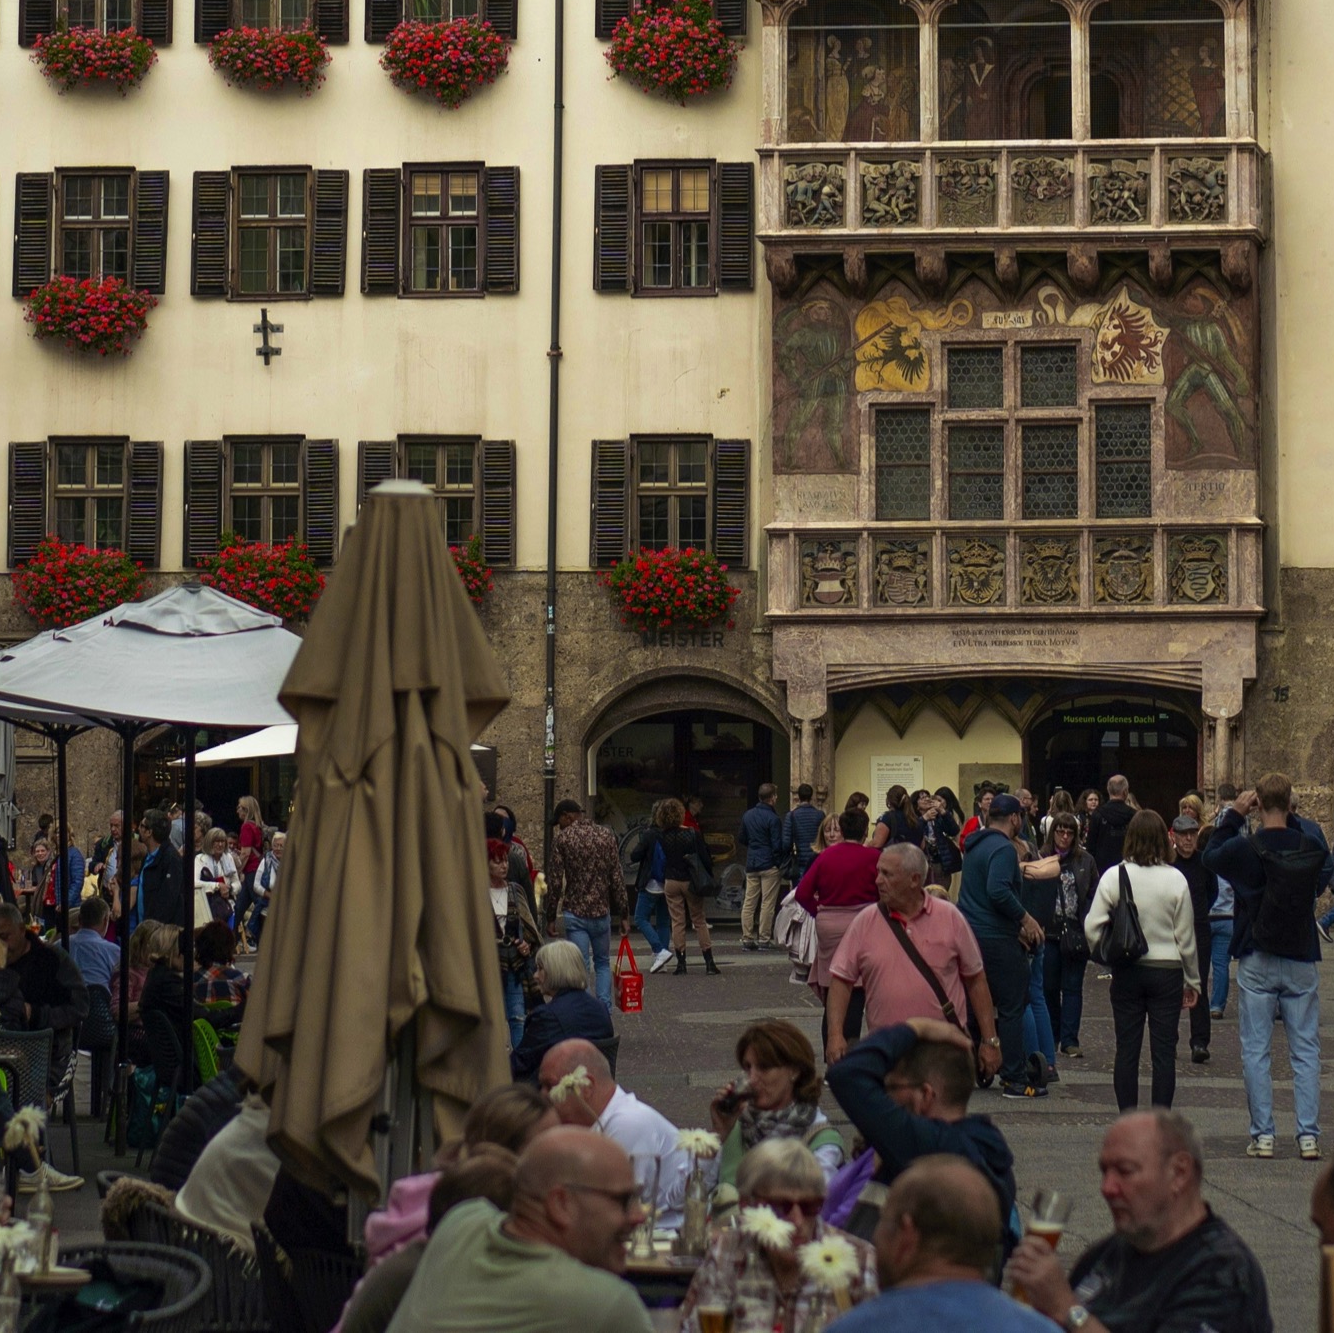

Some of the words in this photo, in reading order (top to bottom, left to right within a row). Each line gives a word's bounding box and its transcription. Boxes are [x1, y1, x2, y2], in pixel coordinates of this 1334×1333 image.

[641, 631, 725, 648] MEISTER
[1272, 684, 1290, 703] 15
[1063, 714, 1096, 724] Museum
[1096, 714, 1132, 724] Goldenes
[1133, 714, 1156, 724] Dachl
